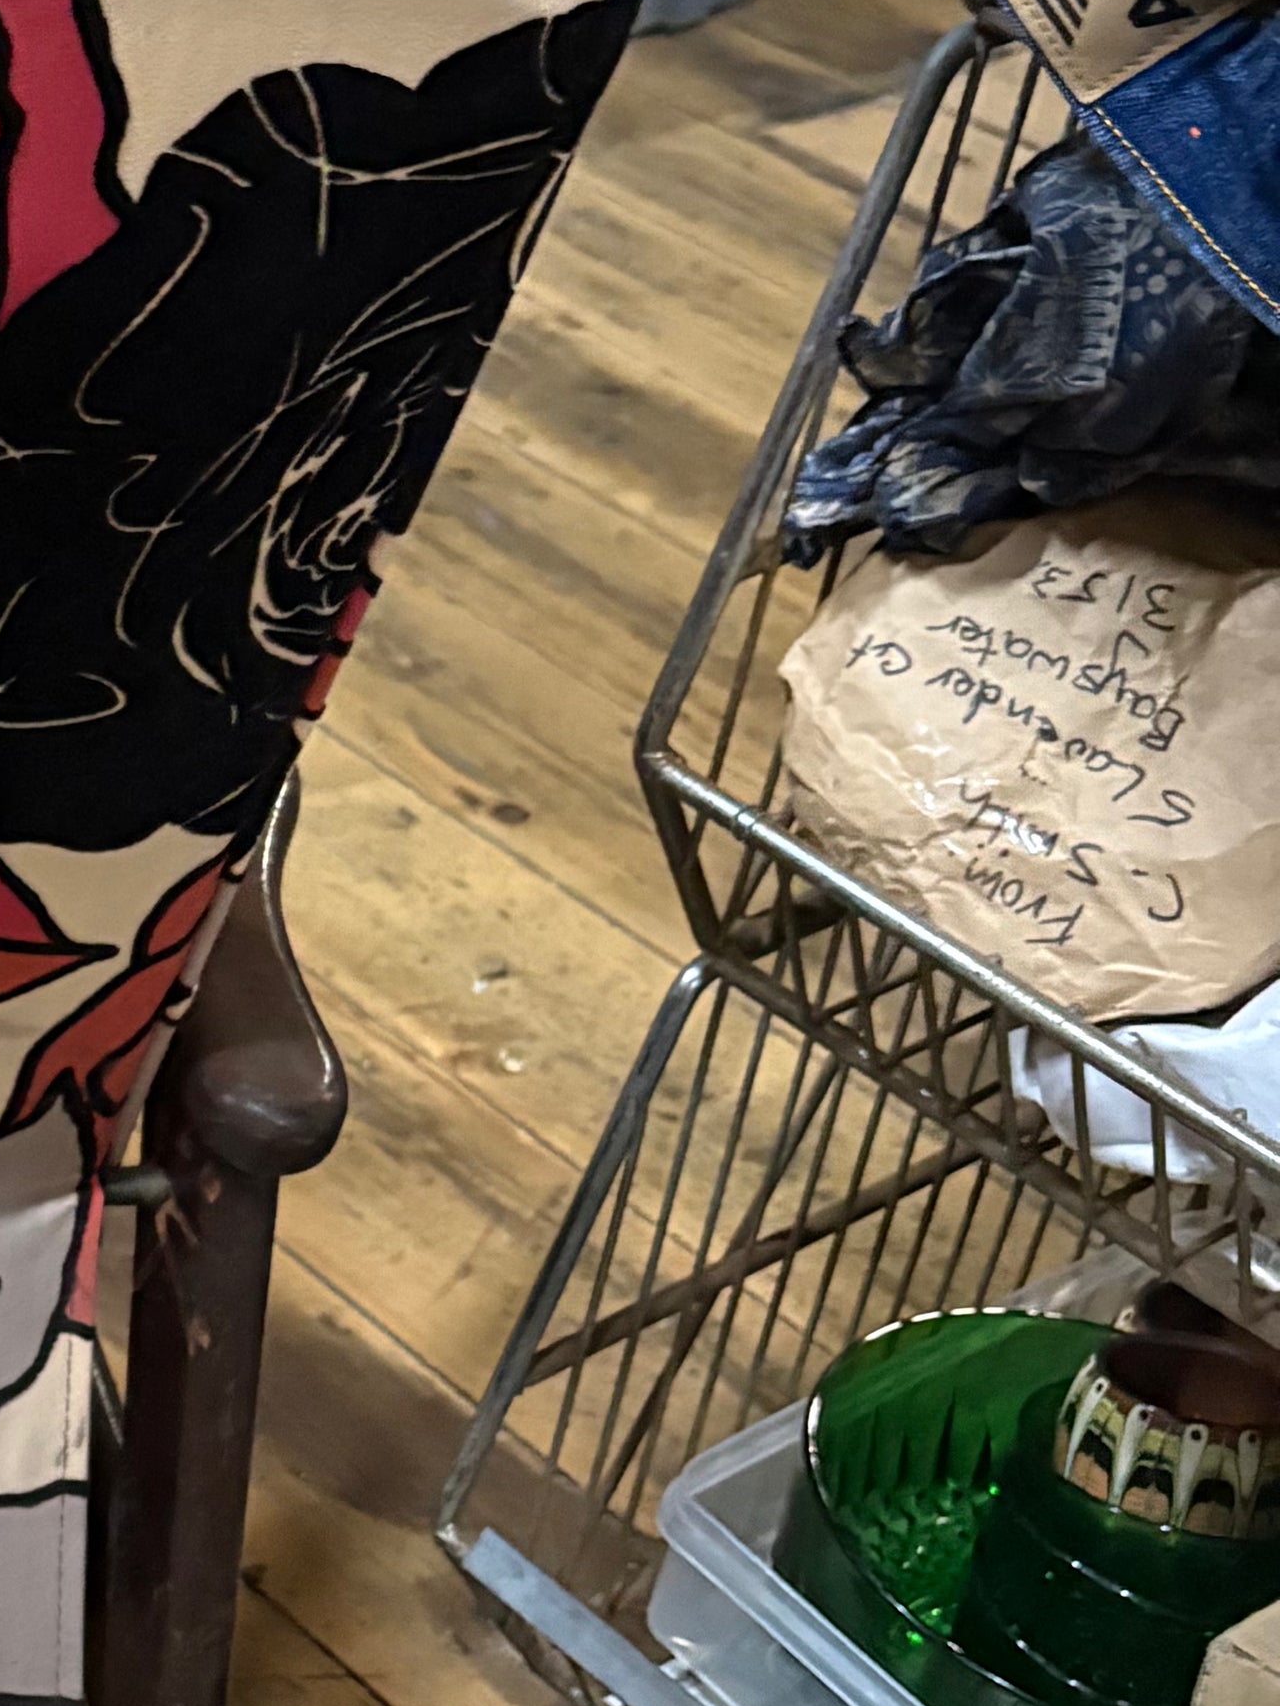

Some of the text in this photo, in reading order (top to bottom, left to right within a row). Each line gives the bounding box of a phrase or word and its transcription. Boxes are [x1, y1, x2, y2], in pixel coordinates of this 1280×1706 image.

[924, 668, 1145, 801] Lavender
[926, 616, 1186, 752] Bayswater
[959, 780, 1104, 887] Smith
